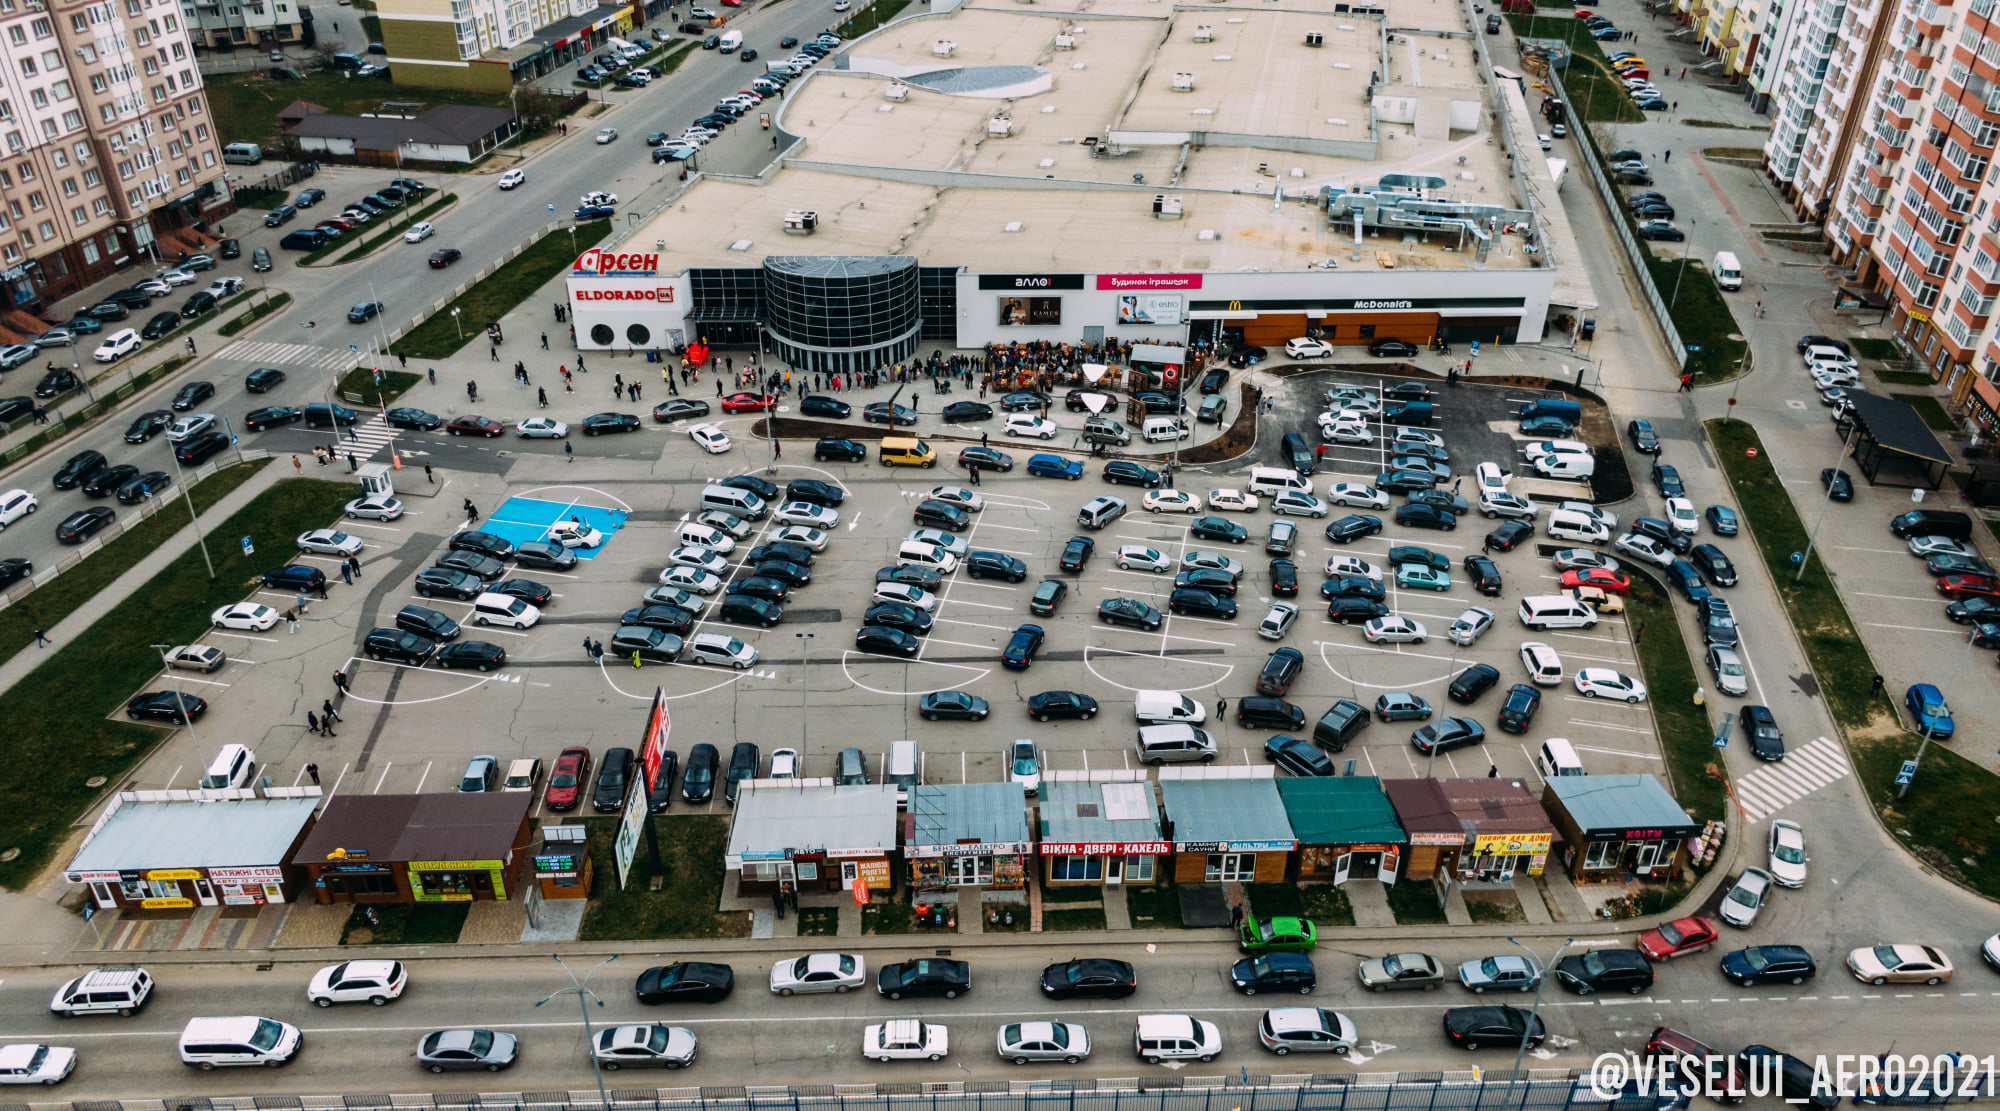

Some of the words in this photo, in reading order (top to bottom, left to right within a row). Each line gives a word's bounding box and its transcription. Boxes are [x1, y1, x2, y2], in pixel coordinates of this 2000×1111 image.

[578, 251, 659, 274] арсен
[1111, 278, 1147, 287] будинок
[576, 290, 656, 300] ELDORADO
[1354, 300, 1412, 308] McDonald's
[932, 844, 961, 852] БЕНЗО
[1042, 844, 1077, 854] ВІКНА
[1083, 844, 1117, 854] ДВЕРІ
[1124, 843, 1168, 854] КАХЕЛЬ
[210, 869, 252, 877] НАТЯЖНІ
[254, 868, 281, 876] СТЕЛІ
